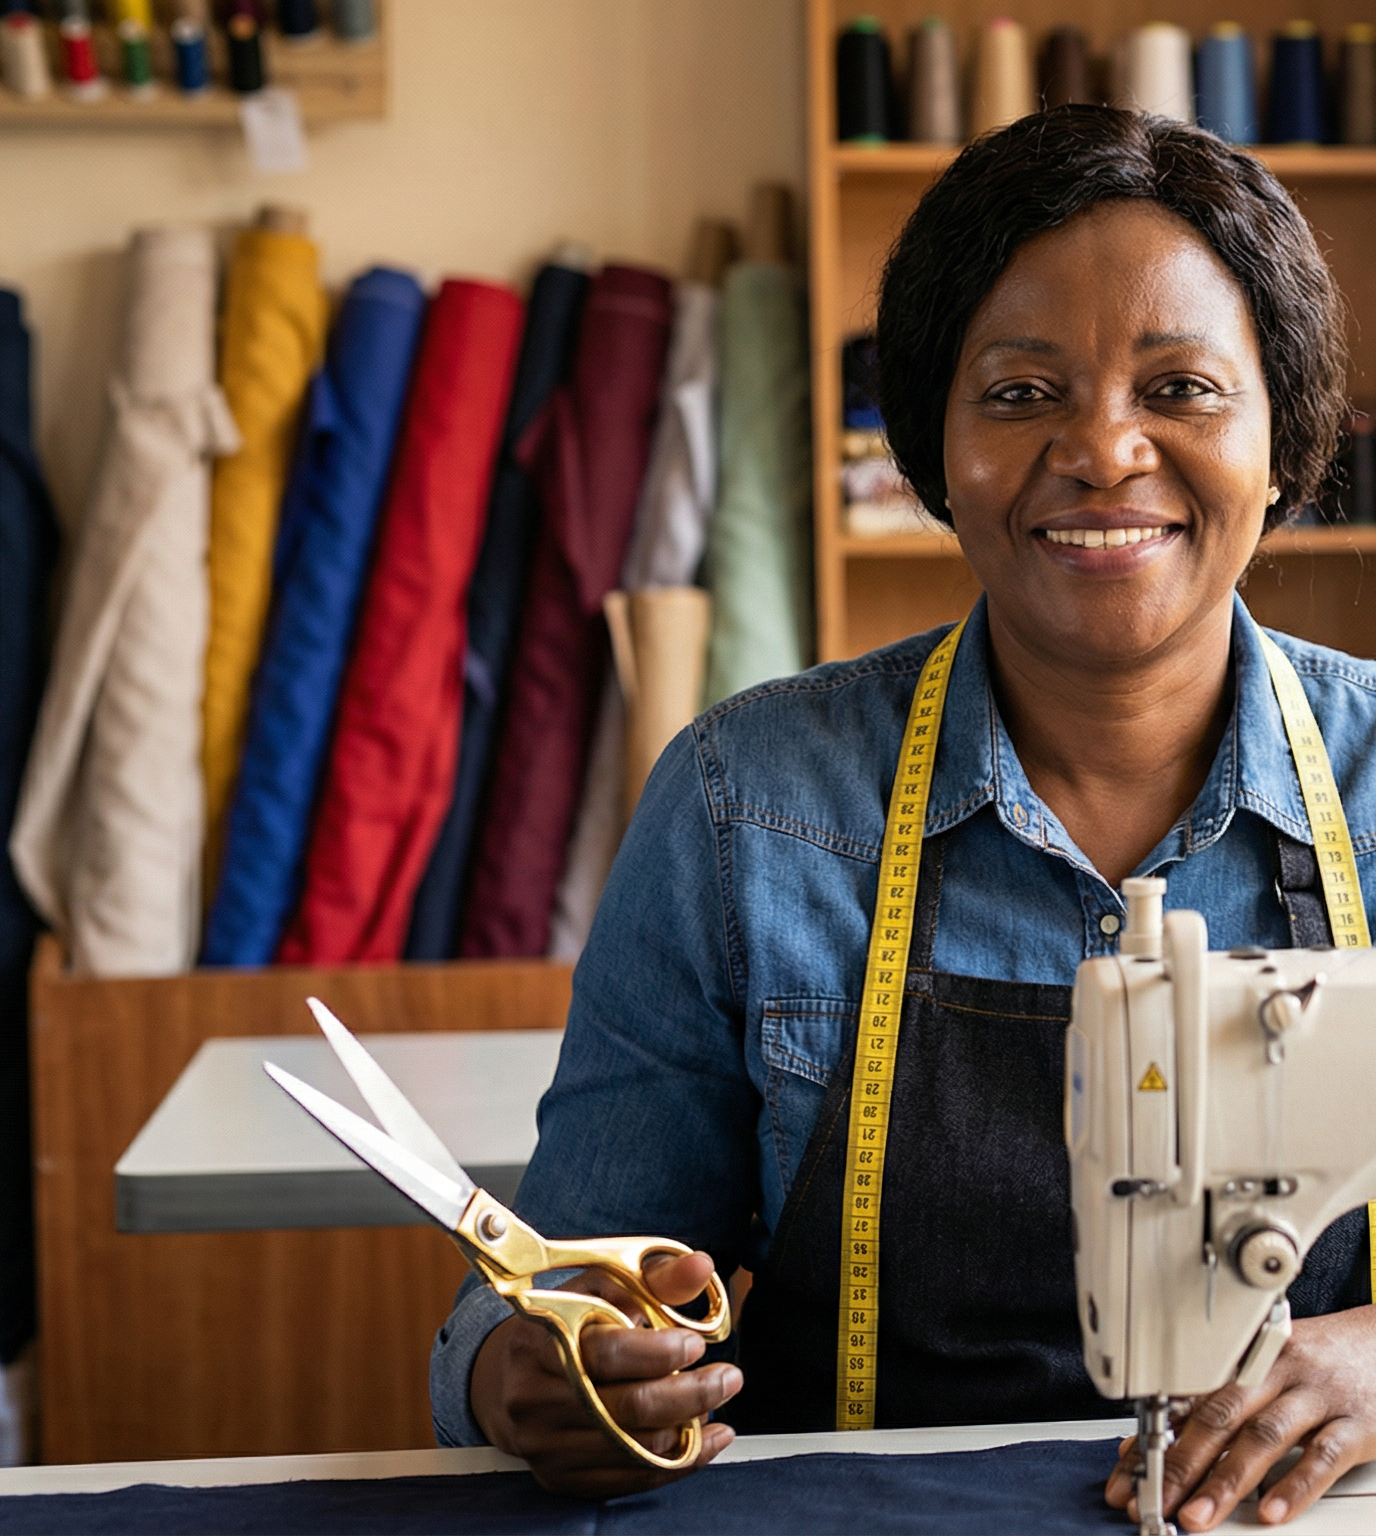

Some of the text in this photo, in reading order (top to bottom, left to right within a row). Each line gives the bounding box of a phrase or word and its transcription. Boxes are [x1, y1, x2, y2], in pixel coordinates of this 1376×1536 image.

[1328, 850, 1343, 863] 13
[870, 1037, 885, 1050] 21
[867, 1060, 883, 1073] 29
[862, 1128, 877, 1141] 21
